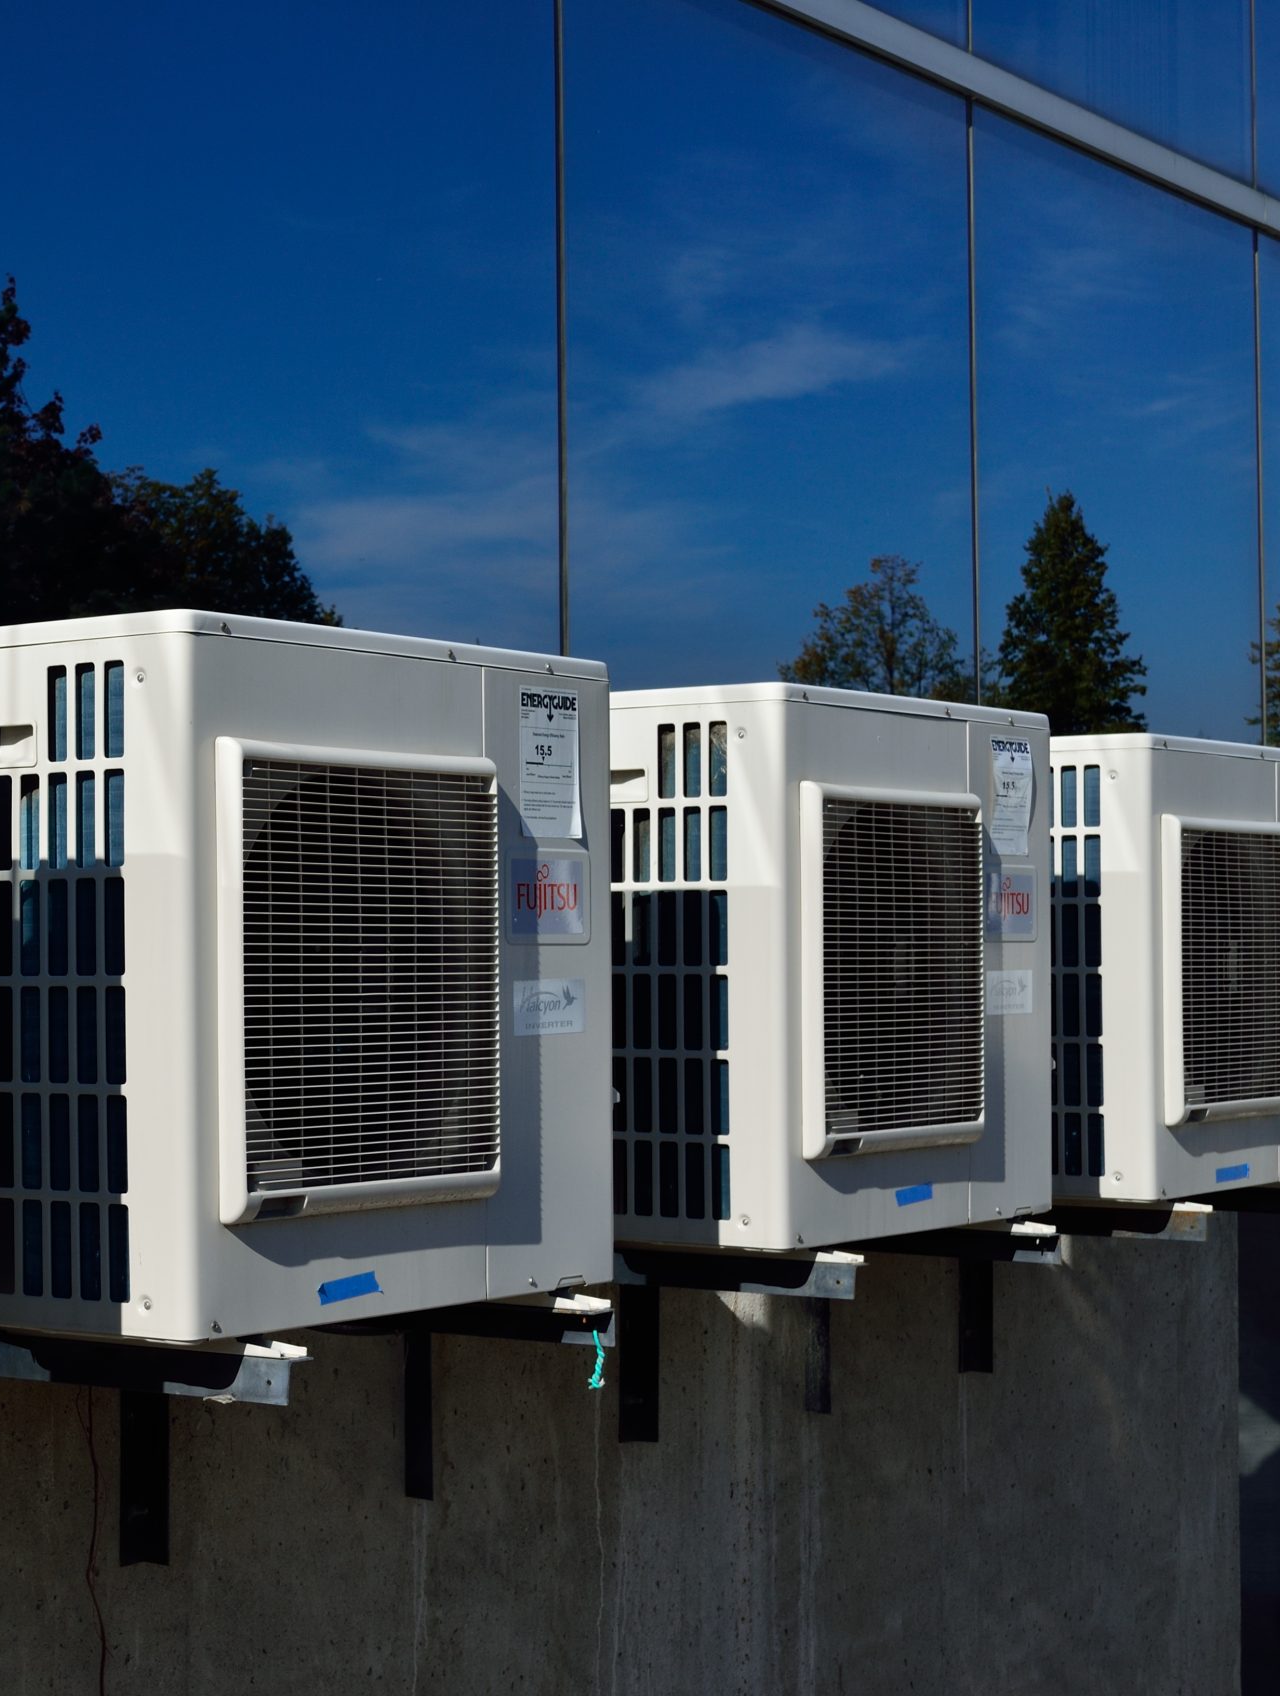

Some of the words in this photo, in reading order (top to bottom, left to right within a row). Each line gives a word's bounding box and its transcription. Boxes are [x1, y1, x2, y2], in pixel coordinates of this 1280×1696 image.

[520, 692, 577, 712] ENERGYGUIDE
[534, 744, 553, 757] 15.5
[1002, 780, 1015, 791] 155
[516, 864, 578, 919] FUJITSU
[991, 877, 1030, 921] UJITSU
[519, 985, 562, 1016] Halcyon
[524, 1020, 574, 1031] INVERTER
